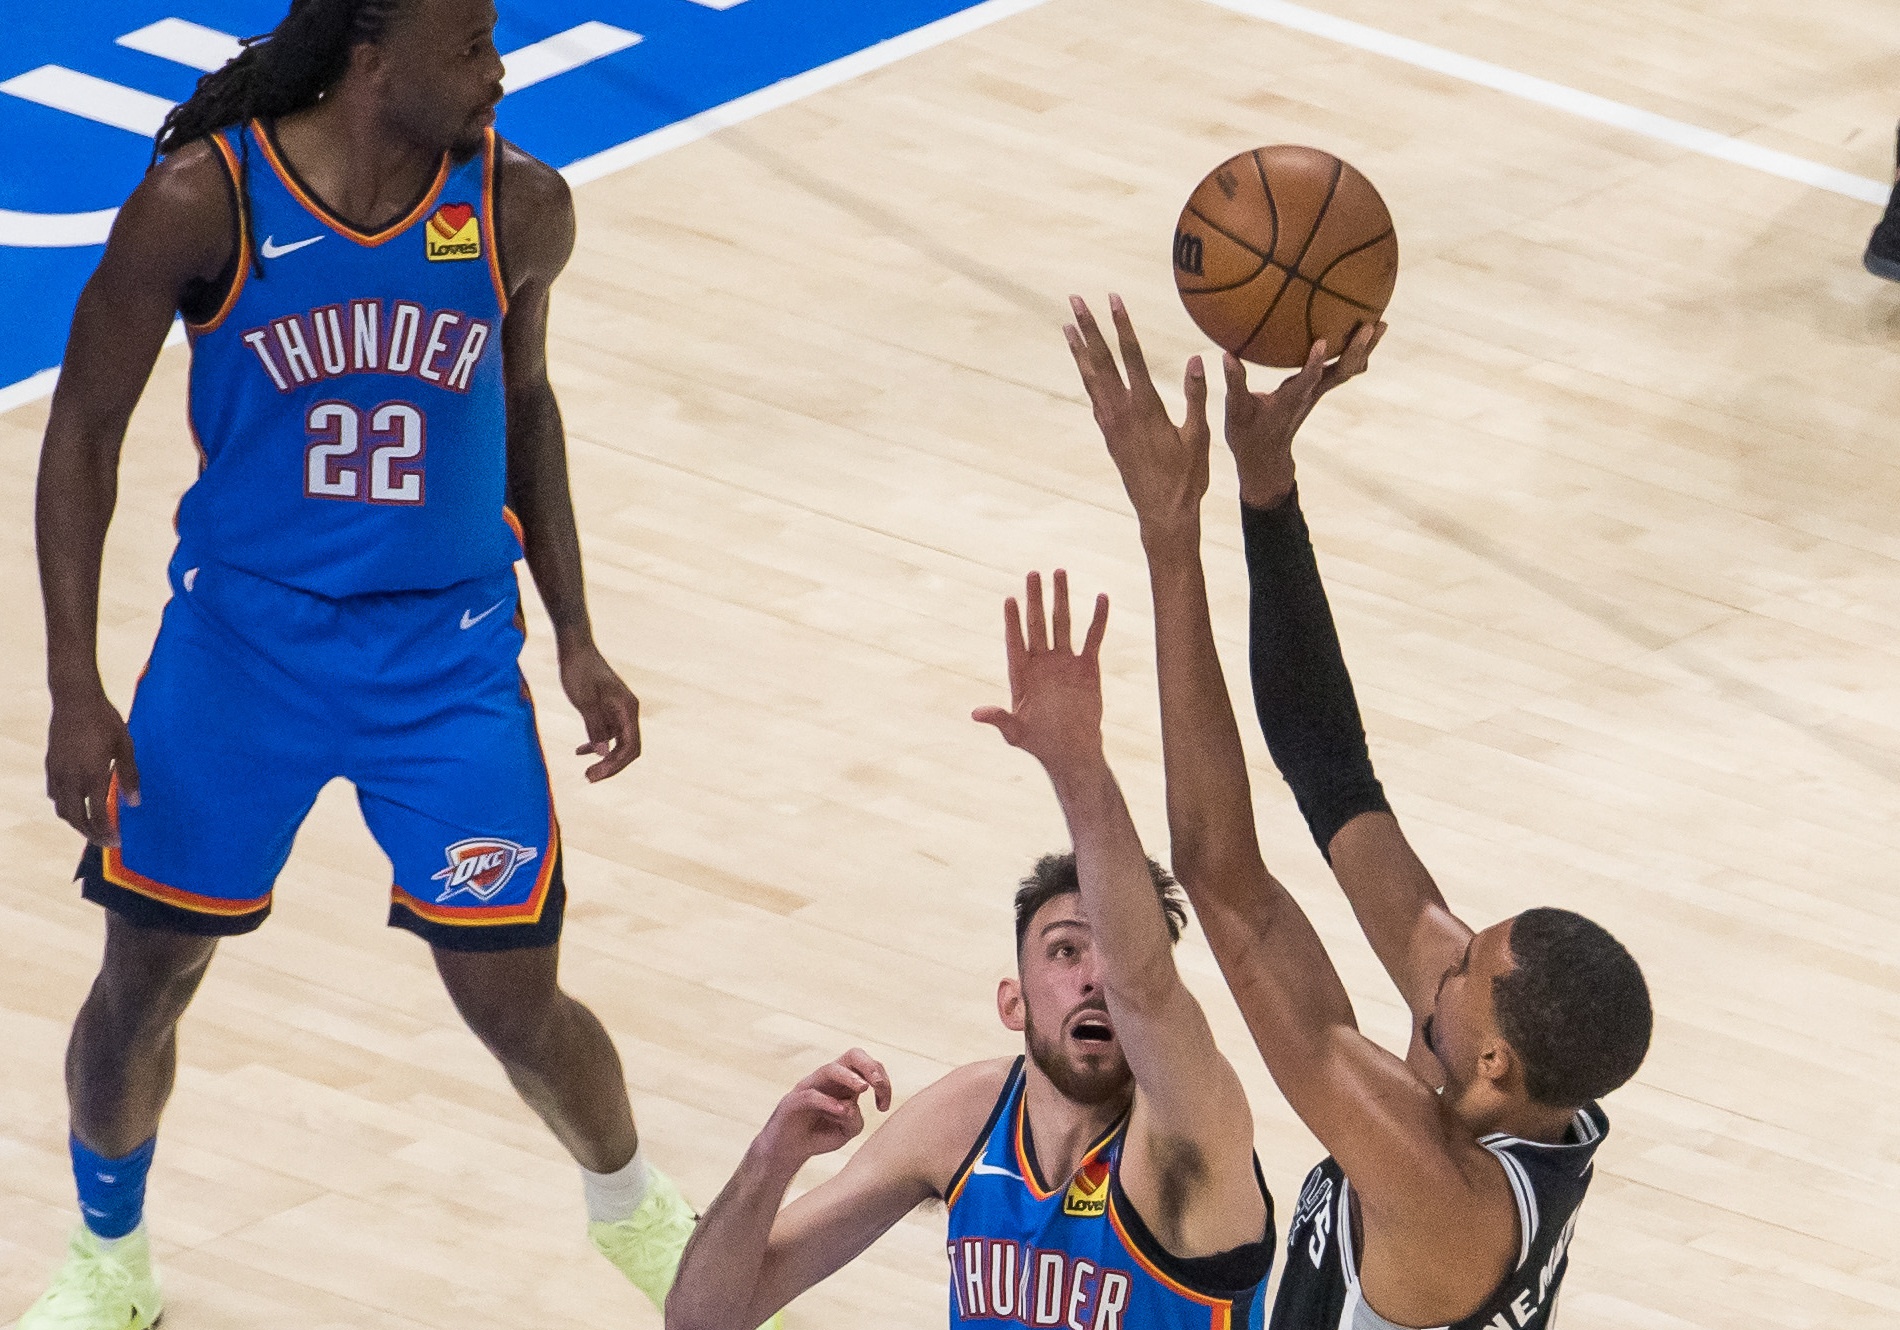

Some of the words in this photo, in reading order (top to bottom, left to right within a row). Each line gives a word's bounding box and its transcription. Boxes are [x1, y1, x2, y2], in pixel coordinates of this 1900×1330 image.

[242, 299, 490, 394] THUNDER
[303, 399, 426, 507] 22
[450, 849, 505, 887] OKC
